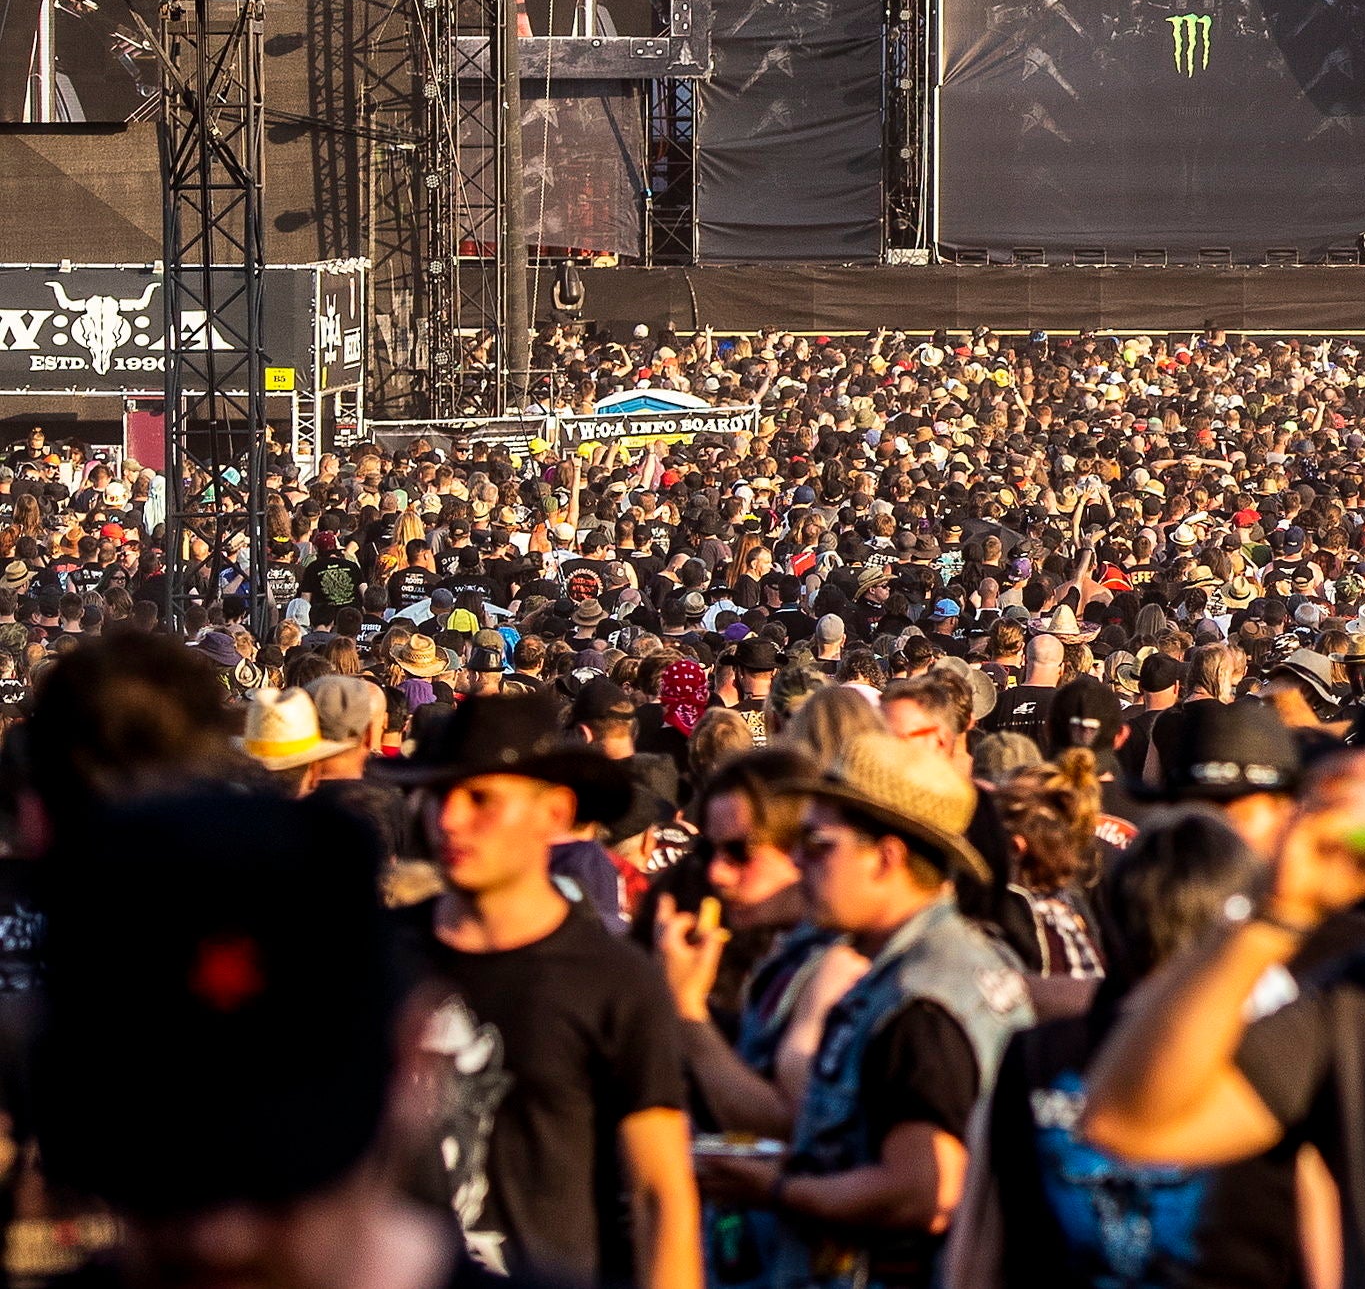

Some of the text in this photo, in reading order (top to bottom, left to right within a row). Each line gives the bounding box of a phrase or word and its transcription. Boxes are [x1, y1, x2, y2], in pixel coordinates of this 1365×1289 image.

[29, 355, 91, 371] ESTD.
[630, 420, 677, 435] INFO
[680, 416, 744, 433] BOARD
